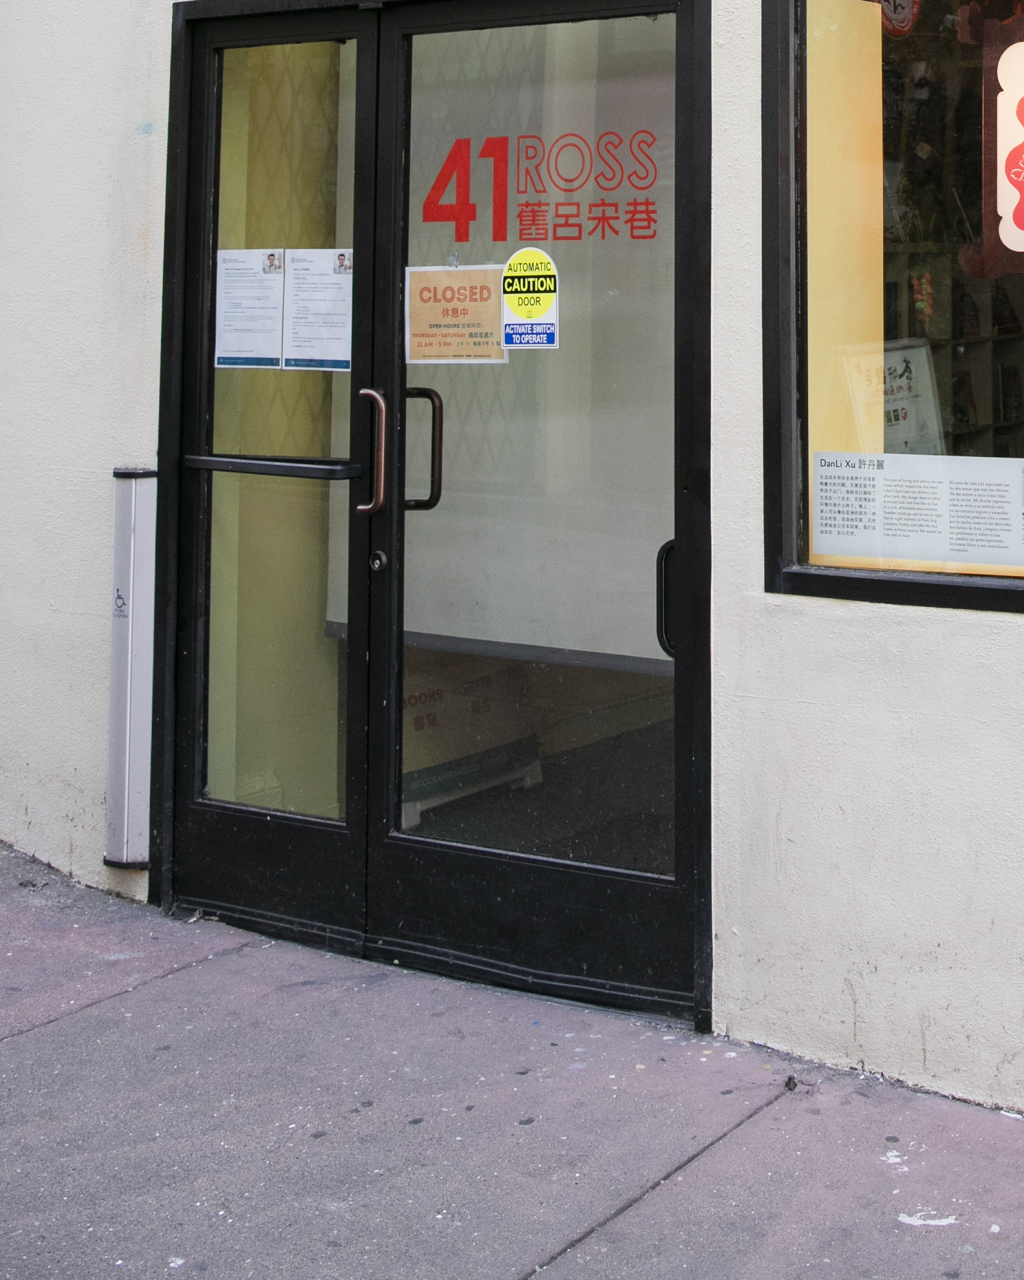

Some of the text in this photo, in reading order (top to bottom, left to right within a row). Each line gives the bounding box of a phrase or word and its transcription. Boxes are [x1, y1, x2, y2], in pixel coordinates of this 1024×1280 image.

[422, 130, 658, 243] 41 ROSS
[516, 198, 658, 241] 舊呂宋巷
[508, 262, 551, 272] AUTOMATIC
[504, 278, 554, 292] CAUTION
[419, 286, 491, 304] CLOSED
[518, 297, 541, 306] DOOR
[442, 308, 468, 318] 休息中
[505, 324, 554, 333] ACTIVATE SWITCH
[512, 334, 547, 343] TO OPERATE
[820, 459, 842, 468] DanLi
[845, 460, 855, 468] Xu
